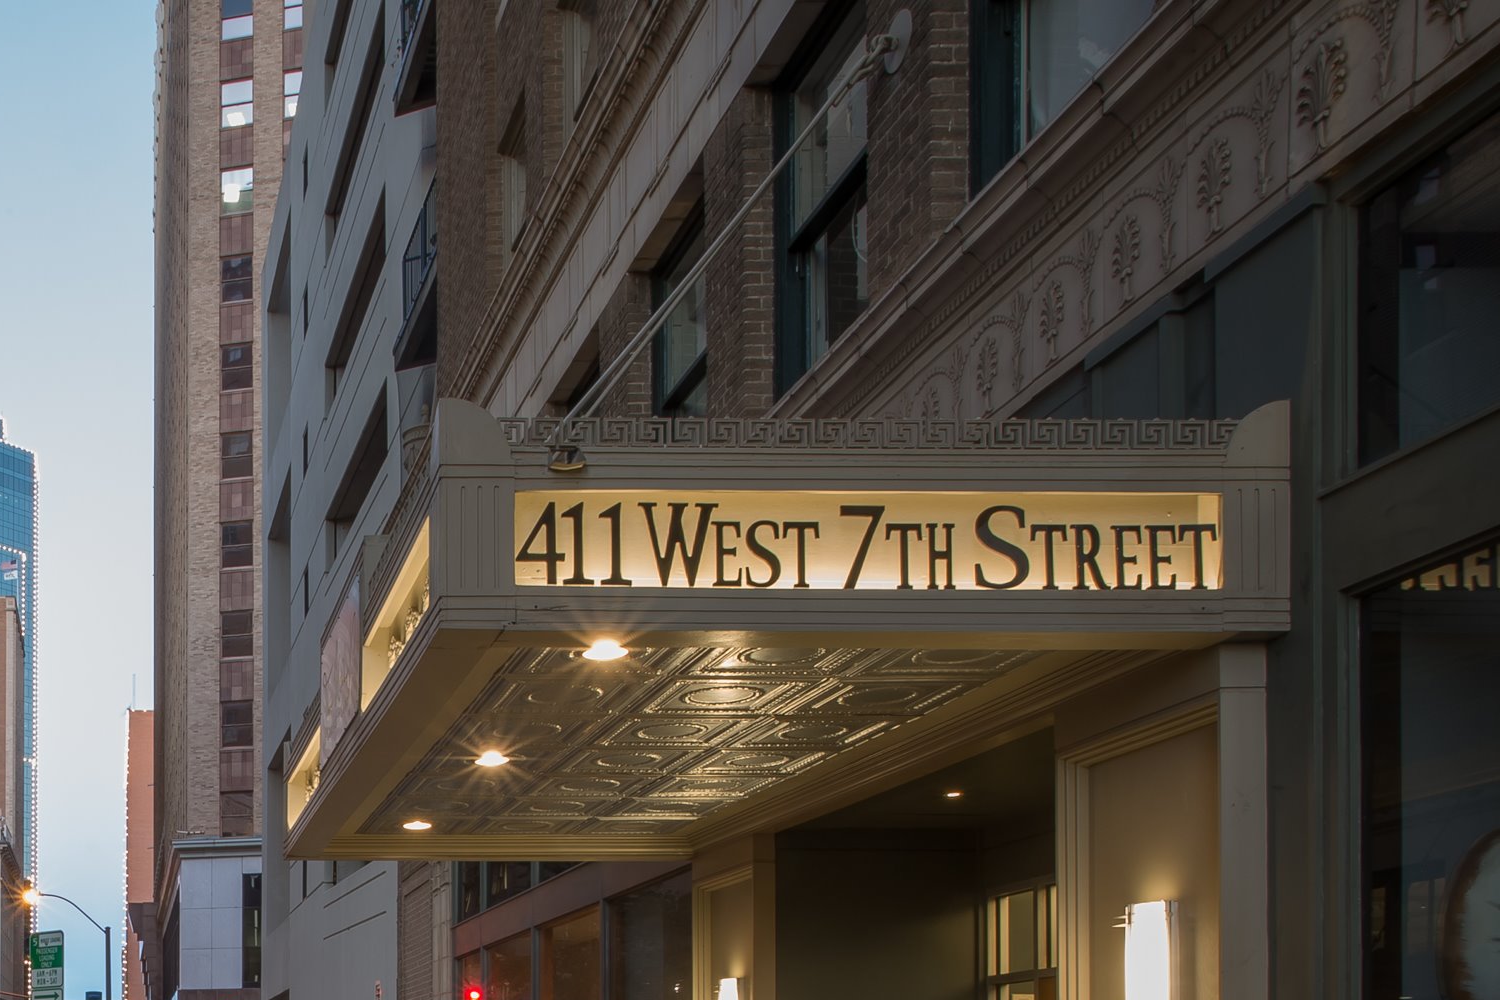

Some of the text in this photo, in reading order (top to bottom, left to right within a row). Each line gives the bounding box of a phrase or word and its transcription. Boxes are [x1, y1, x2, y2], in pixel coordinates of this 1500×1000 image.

[515, 501, 1217, 590] 411 WEST 7TH STREET
